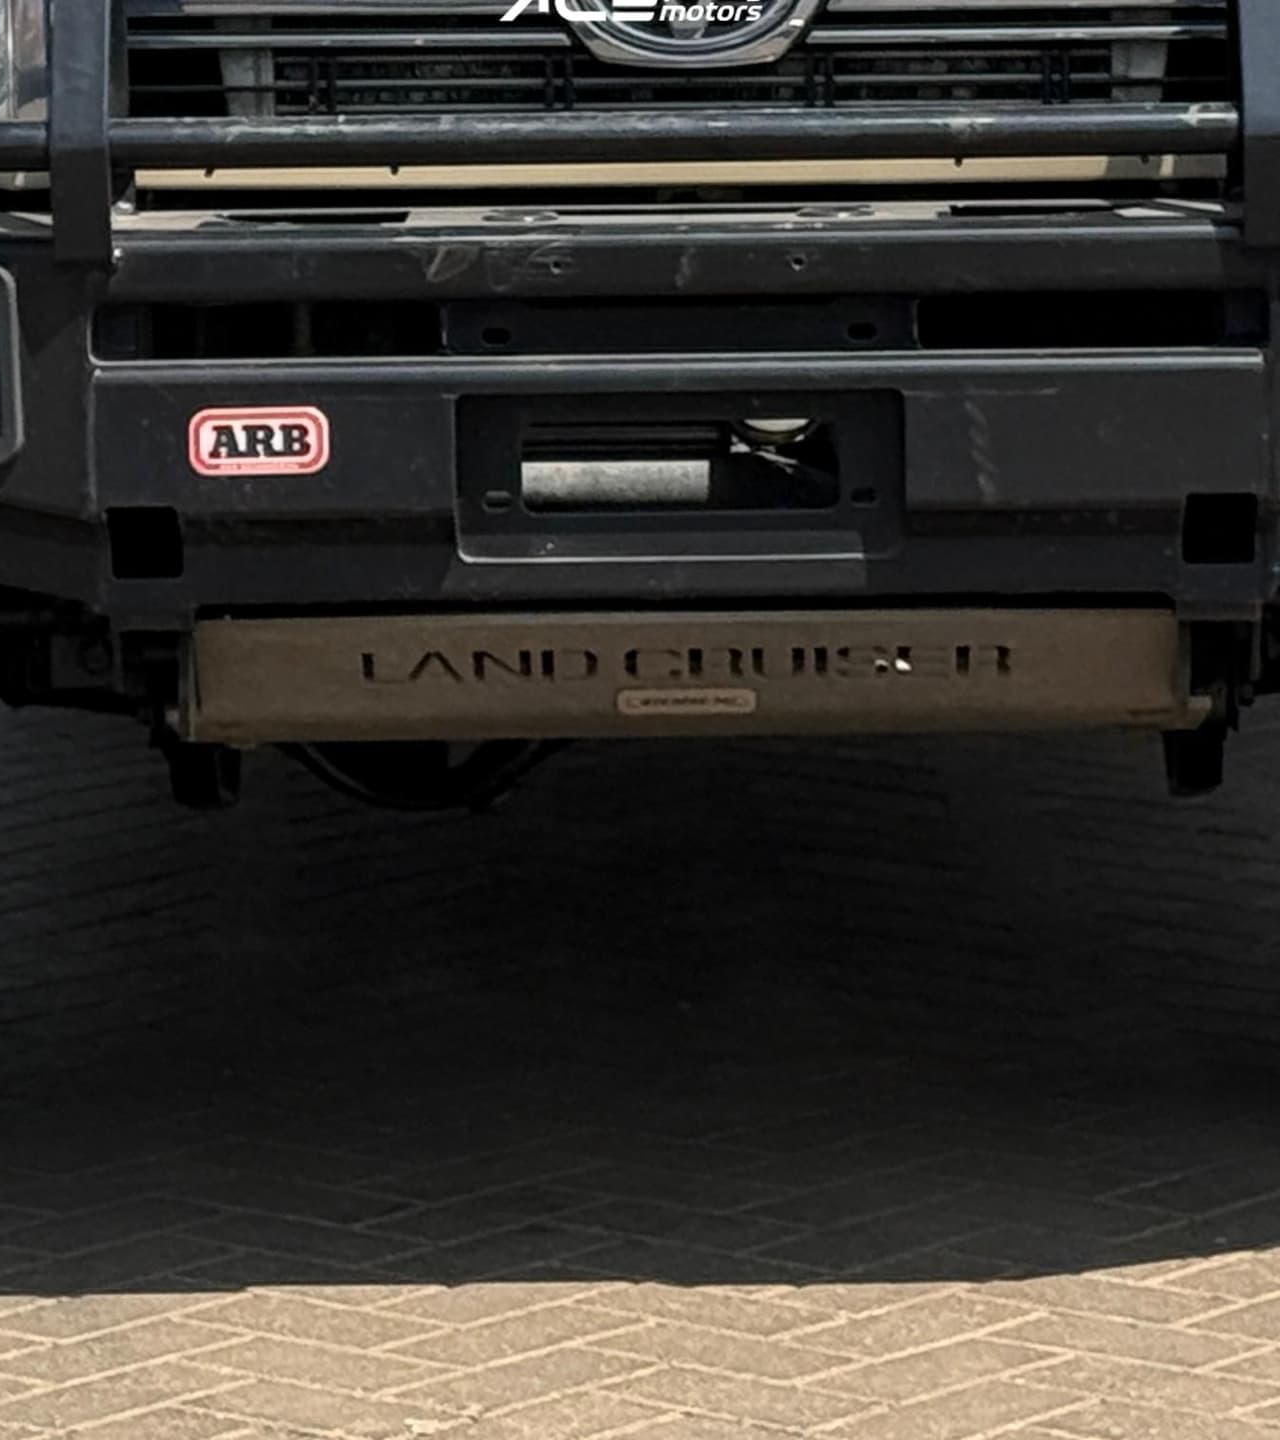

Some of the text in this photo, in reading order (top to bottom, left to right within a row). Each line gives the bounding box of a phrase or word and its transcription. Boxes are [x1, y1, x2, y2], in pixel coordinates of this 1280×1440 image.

[208, 423, 311, 458] ARB
[361, 644, 1013, 684] LAND CRUISER
